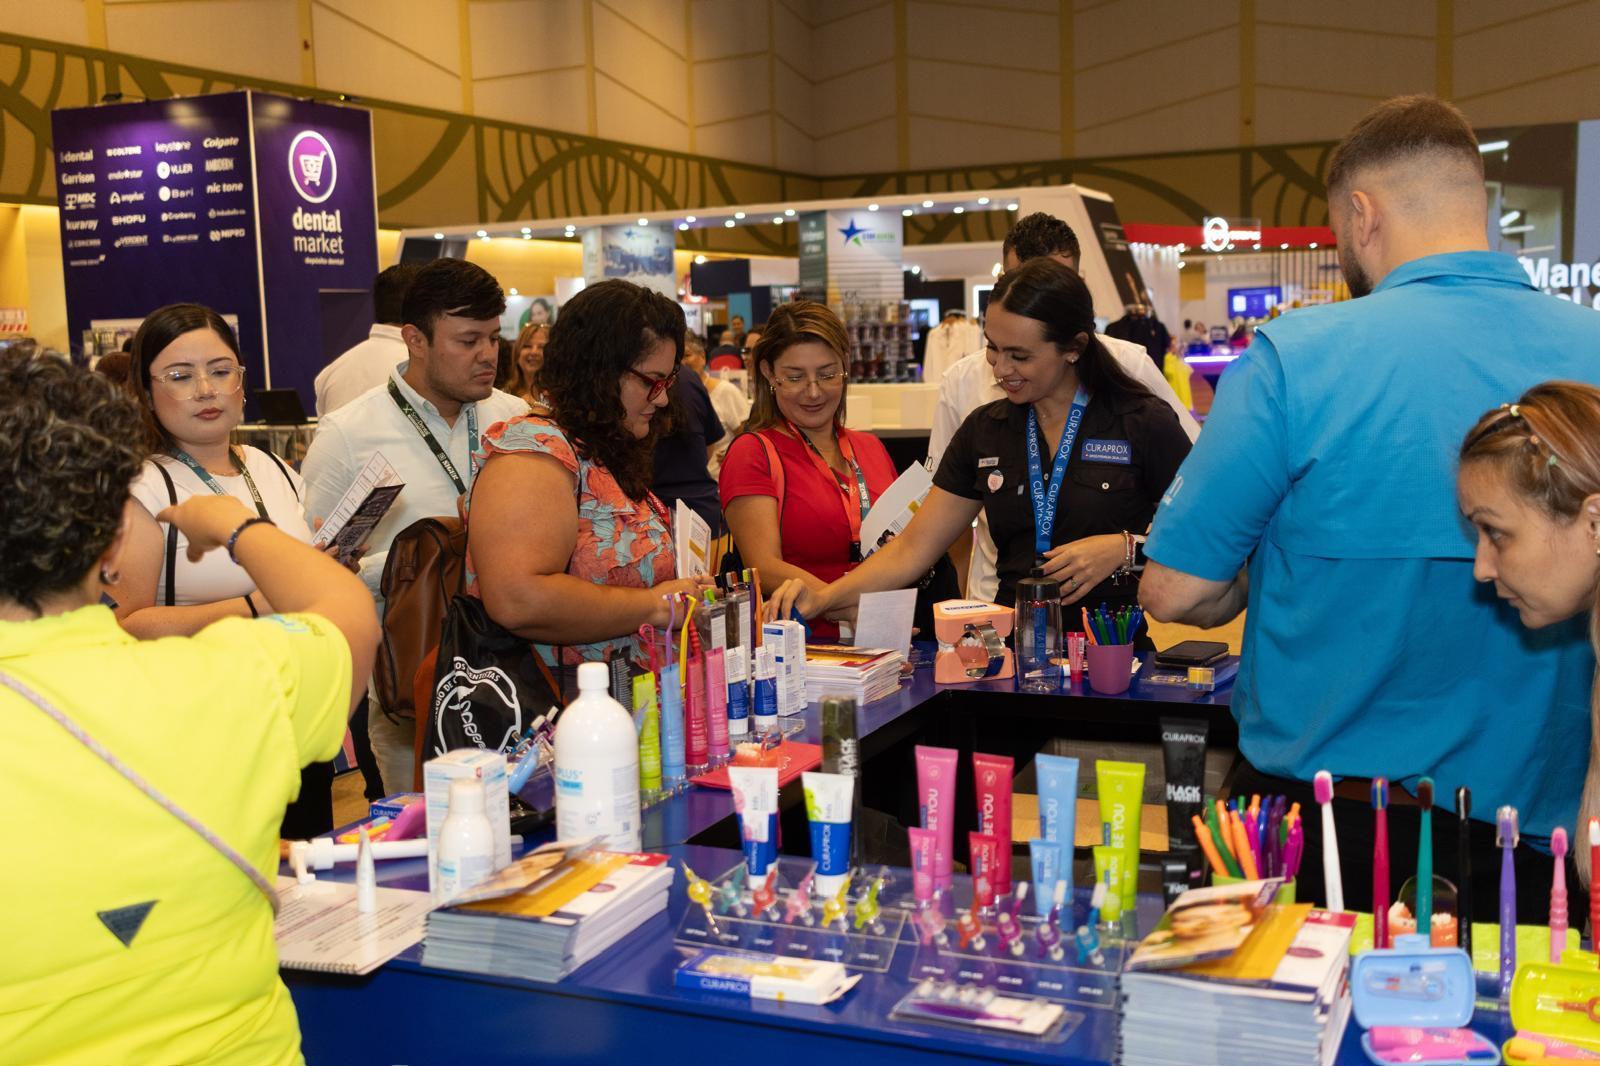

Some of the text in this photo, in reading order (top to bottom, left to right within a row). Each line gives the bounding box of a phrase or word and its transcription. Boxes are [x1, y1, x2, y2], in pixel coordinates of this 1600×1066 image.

[203, 137, 239, 149] Colgate
[62, 172, 95, 185] Garrison
[206, 182, 243, 194] nic tone
[112, 214, 146, 226] SHOFU
[292, 206, 342, 233] dental
[294, 233, 344, 255] market
[1029, 408, 1039, 459] CURAPROX
[1058, 409, 1082, 460] CURAPROX
[1086, 443, 1128, 454] CURAPROX
[1041, 483, 1059, 536] CURAPROX
[444, 681, 454, 692] DE
[1162, 732, 1206, 744] CURAPROX
[928, 788, 939, 831] BE YOU
[983, 794, 994, 836] BE YOU
[1046, 798, 1058, 842] BE YOU
[1112, 803, 1125, 848] BE YOU
[821, 824, 831, 871] CURAPROX
[700, 976, 750, 993] CURAPROX
